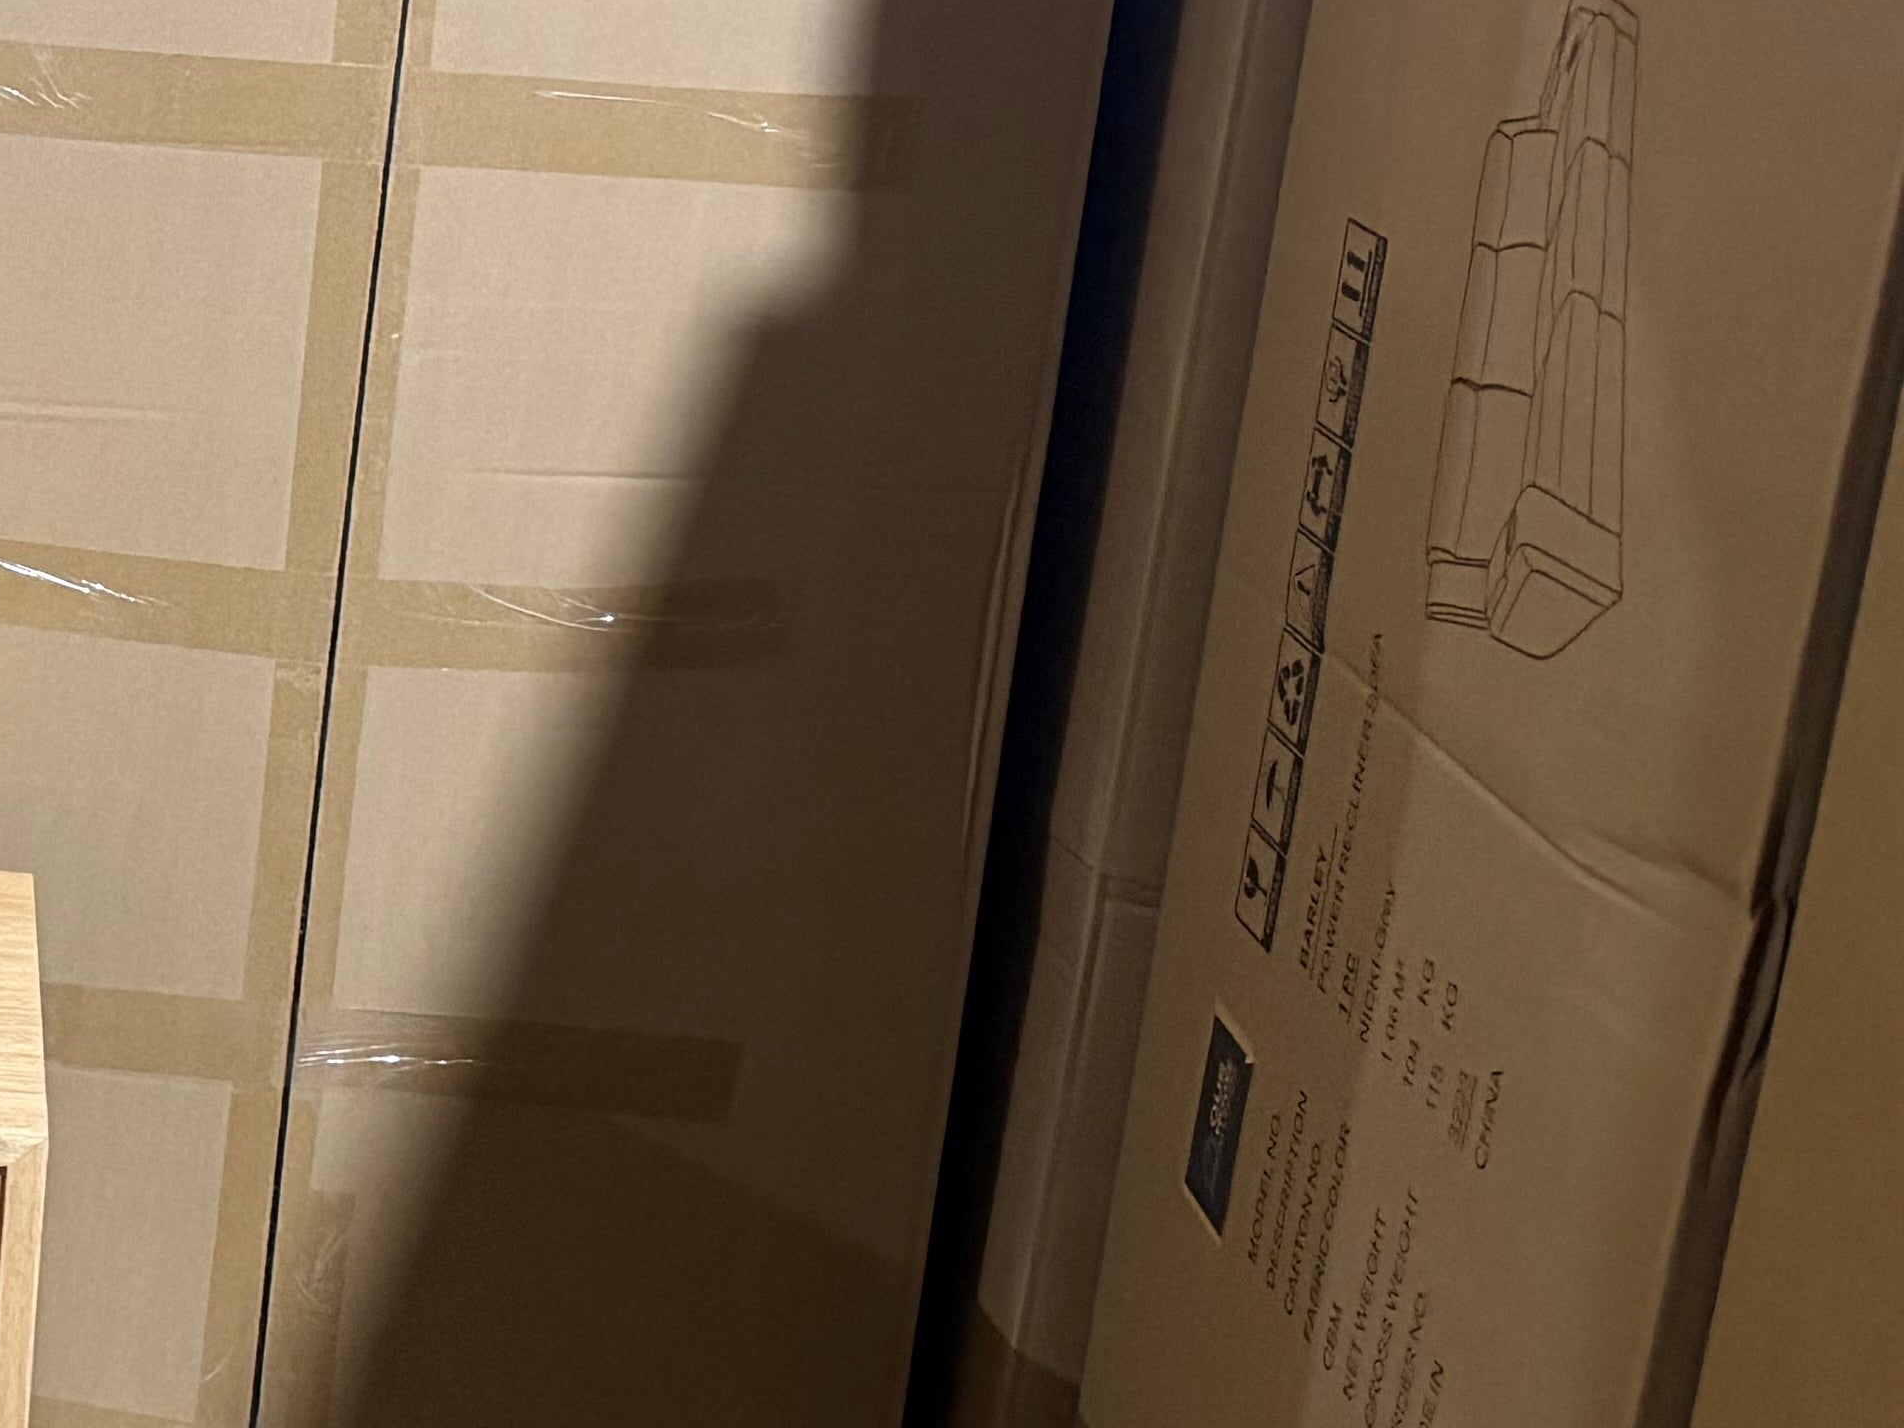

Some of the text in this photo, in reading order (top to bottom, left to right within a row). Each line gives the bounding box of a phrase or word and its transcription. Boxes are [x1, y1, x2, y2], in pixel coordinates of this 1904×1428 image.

[1298, 843, 1328, 971] BARLEY
[1316, 879, 1346, 995] POWER
[1337, 717, 1375, 876] RECLINER
[1473, 1070, 1505, 1171] CHINA
[1246, 1167, 1275, 1266] MODEL
[1265, 1088, 1309, 1292] DESCRIPTION
[1283, 1190, 1314, 1317] CARTON
[1302, 1119, 1352, 1346] FABRIC COLOR
[1384, 1184, 1420, 1312] WEIGHT
[1322, 1300, 1343, 1372] CBM
[1341, 1205, 1387, 1402] NET WEIGHT
[1428, 1358, 1445, 1397] IN
